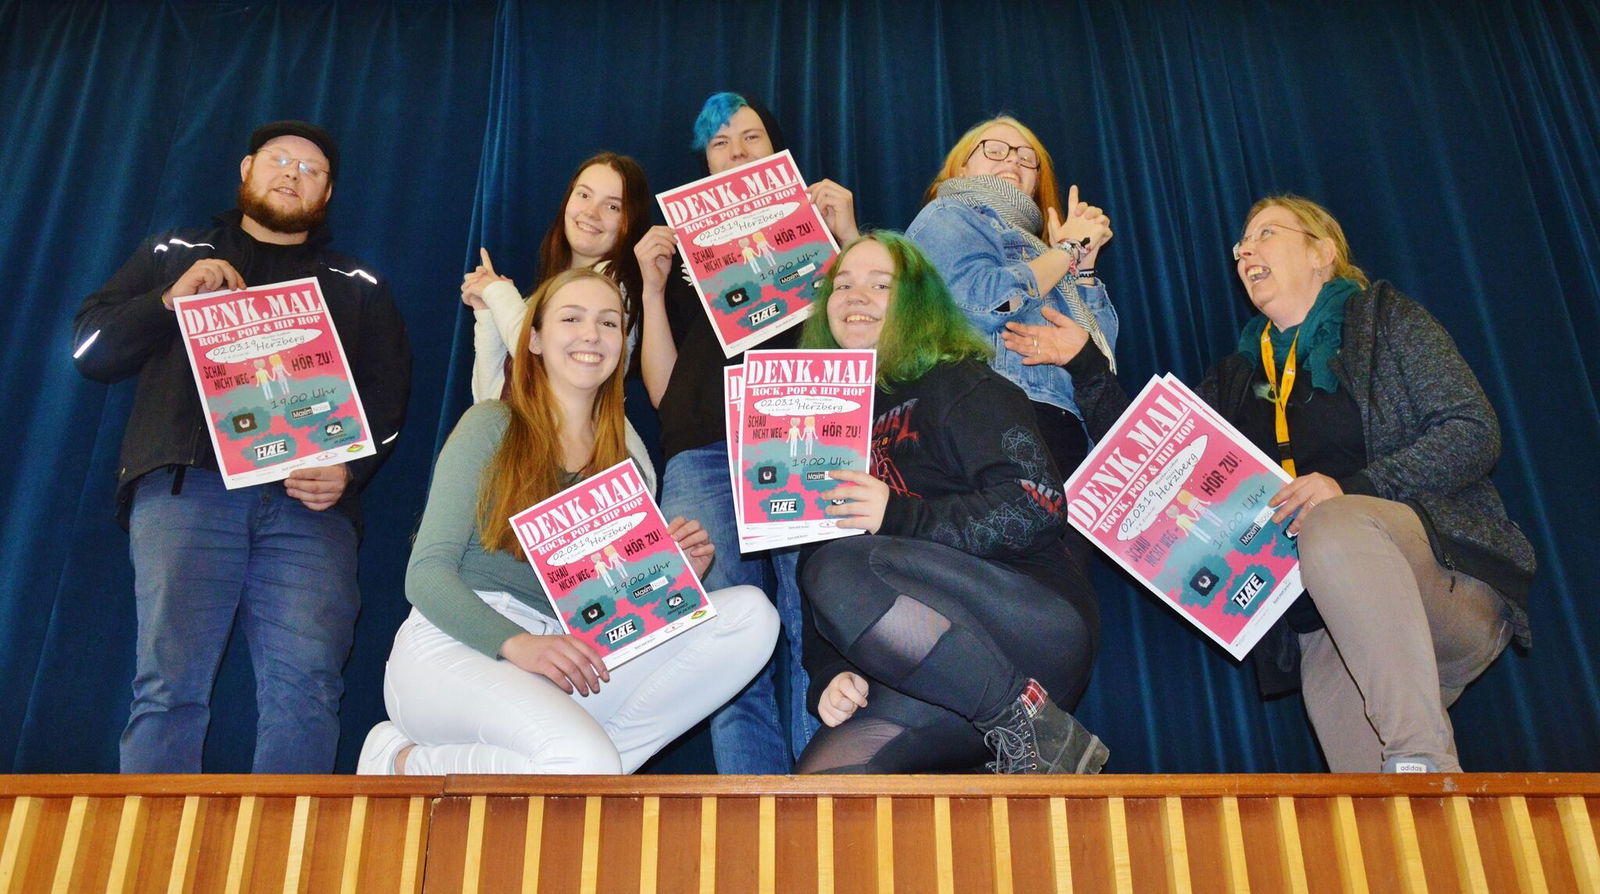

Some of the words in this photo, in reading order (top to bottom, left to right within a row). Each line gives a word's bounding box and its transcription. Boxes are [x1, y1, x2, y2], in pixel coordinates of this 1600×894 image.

[667, 163, 798, 226] DENK.MAL
[684, 216, 719, 236] ROCK,
[719, 207, 742, 222] POP
[742, 204, 752, 213] &
[752, 195, 774, 210] HIP
[774, 186, 799, 202] HOP
[698, 220, 740, 241] 02.03.19
[738, 211, 786, 232] Herzberg
[774, 228, 797, 245] HÖR
[797, 221, 816, 238] ZU!
[692, 246, 716, 266] SCHAU
[703, 257, 724, 274] NICHT
[760, 260, 795, 283] 19.00
[796, 250, 820, 265] Uhr
[183, 290, 323, 335] DENK.MAL
[199, 333, 236, 347] ROCK,
[237, 327, 262, 339] POP
[262, 324, 273, 333] &
[274, 319, 296, 331] HIP
[298, 315, 323, 326] HOP
[212, 340, 258, 357] 02.03.19
[255, 336, 307, 351] Herzberg
[203, 363, 228, 380] SCHAU
[291, 354, 315, 372] HÖR
[315, 351, 335, 367] ZU!
[748, 360, 871, 384] DENK.MAL
[213, 376, 235, 391] NICHT
[753, 388, 784, 397] ROCK,
[787, 387, 808, 396] POP
[820, 387, 841, 396] HIP
[843, 388, 866, 396] HOP
[270, 393, 310, 410] 19.00
[311, 388, 338, 399] Uhr
[761, 399, 800, 407] 02.03.19
[798, 403, 843, 412] Herzberg
[748, 416, 767, 428] SCHAU
[822, 422, 842, 438] HÖR
[846, 426, 862, 439] ZU!
[753, 429, 769, 440] NICHT
[792, 458, 826, 467] 19.00
[829, 458, 855, 467] Uhr
[1066, 394, 1190, 530] DENK.MAL
[1199, 469, 1228, 497] HÖR
[1218, 451, 1244, 476] ZU!
[1099, 497, 1133, 534] ROCK,
[1127, 473, 1153, 500] POP
[1147, 464, 1161, 477] &
[1155, 442, 1179, 467] HIP
[1173, 418, 1199, 445] HOP
[1119, 490, 1158, 534] 02.03.19
[1154, 453, 1200, 500] Herzberg
[519, 471, 645, 548] DENK.MAL
[1211, 511, 1248, 551] 19.00
[1241, 485, 1267, 512] Uhr
[537, 534, 571, 556] ROCK,
[570, 523, 593, 539] POP
[591, 519, 602, 529] &
[603, 508, 624, 523] HIP
[622, 497, 646, 513] HOP
[552, 537, 591, 561] 02.03.19
[588, 522, 634, 547] Herzberg
[623, 538, 647, 557] HÖR
[645, 529, 664, 546] ZU!
[546, 566, 571, 584] SCHAU
[558, 575, 579, 592] NICHT
[612, 572, 648, 595] 19.00
[648, 561, 672, 577] Uhr
[1400, 764, 1422, 772] adidas
